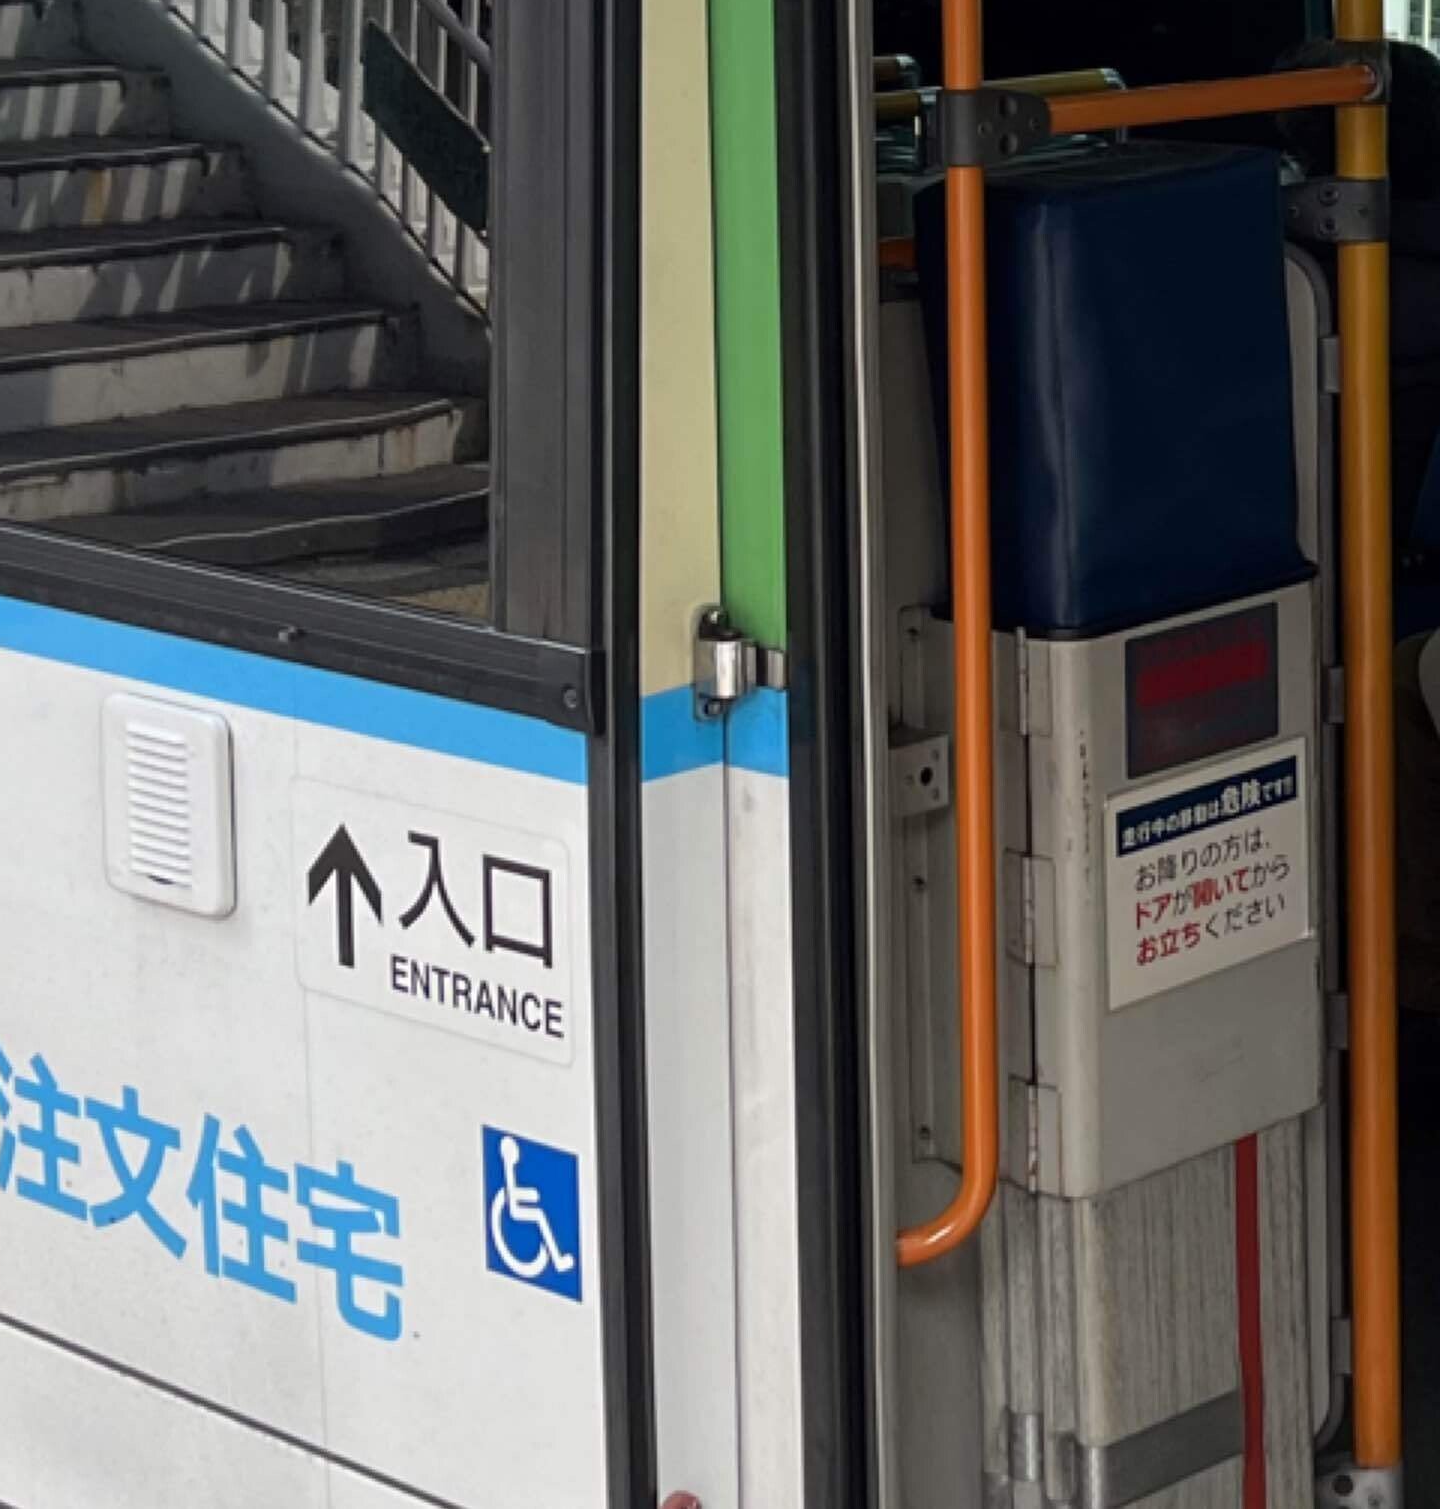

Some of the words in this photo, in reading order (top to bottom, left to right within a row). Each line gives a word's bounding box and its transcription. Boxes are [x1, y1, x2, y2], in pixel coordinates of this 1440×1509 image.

[398, 829, 554, 970] 入口
[1136, 892, 1286, 966] お立ちください
[390, 953, 566, 1039] ENTRANCE
